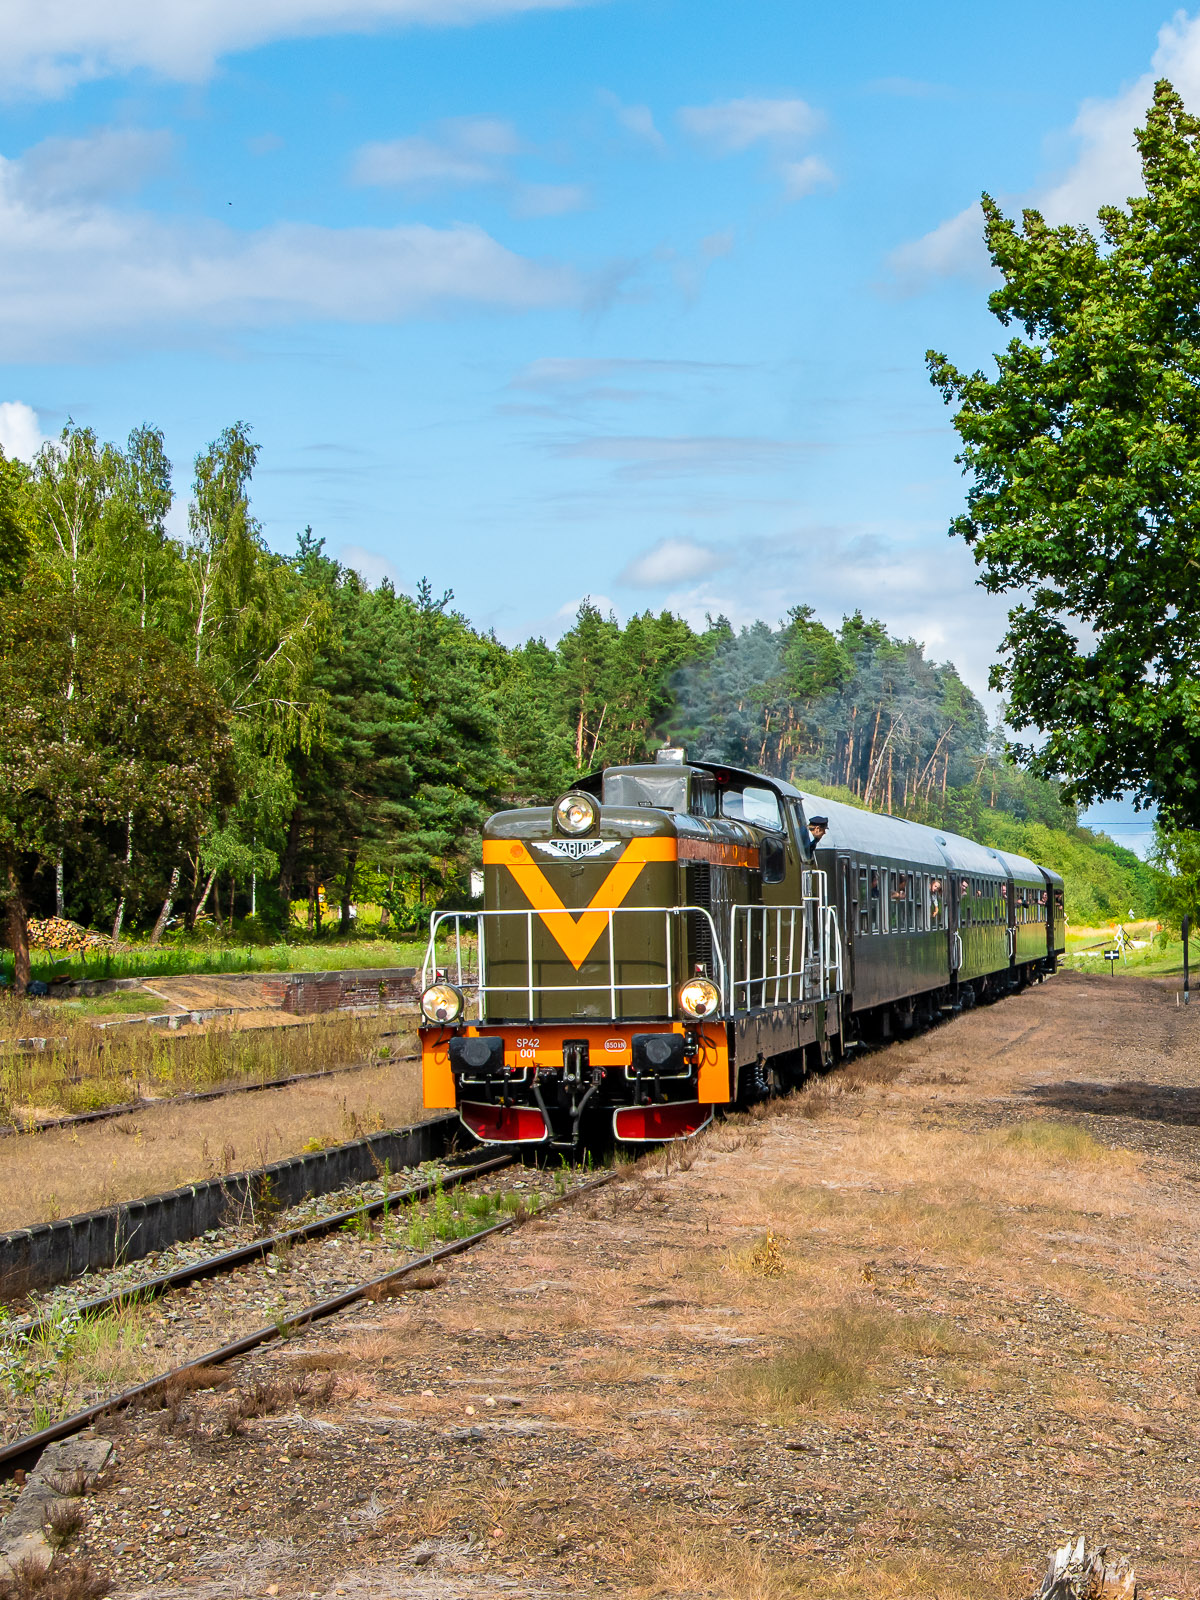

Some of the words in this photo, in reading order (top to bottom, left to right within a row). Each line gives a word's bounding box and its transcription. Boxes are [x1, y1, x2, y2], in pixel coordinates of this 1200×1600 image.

[556, 842, 597, 858] FABLOK
[516, 1038, 540, 1048] SP42
[520, 1048, 536, 1058] 001
